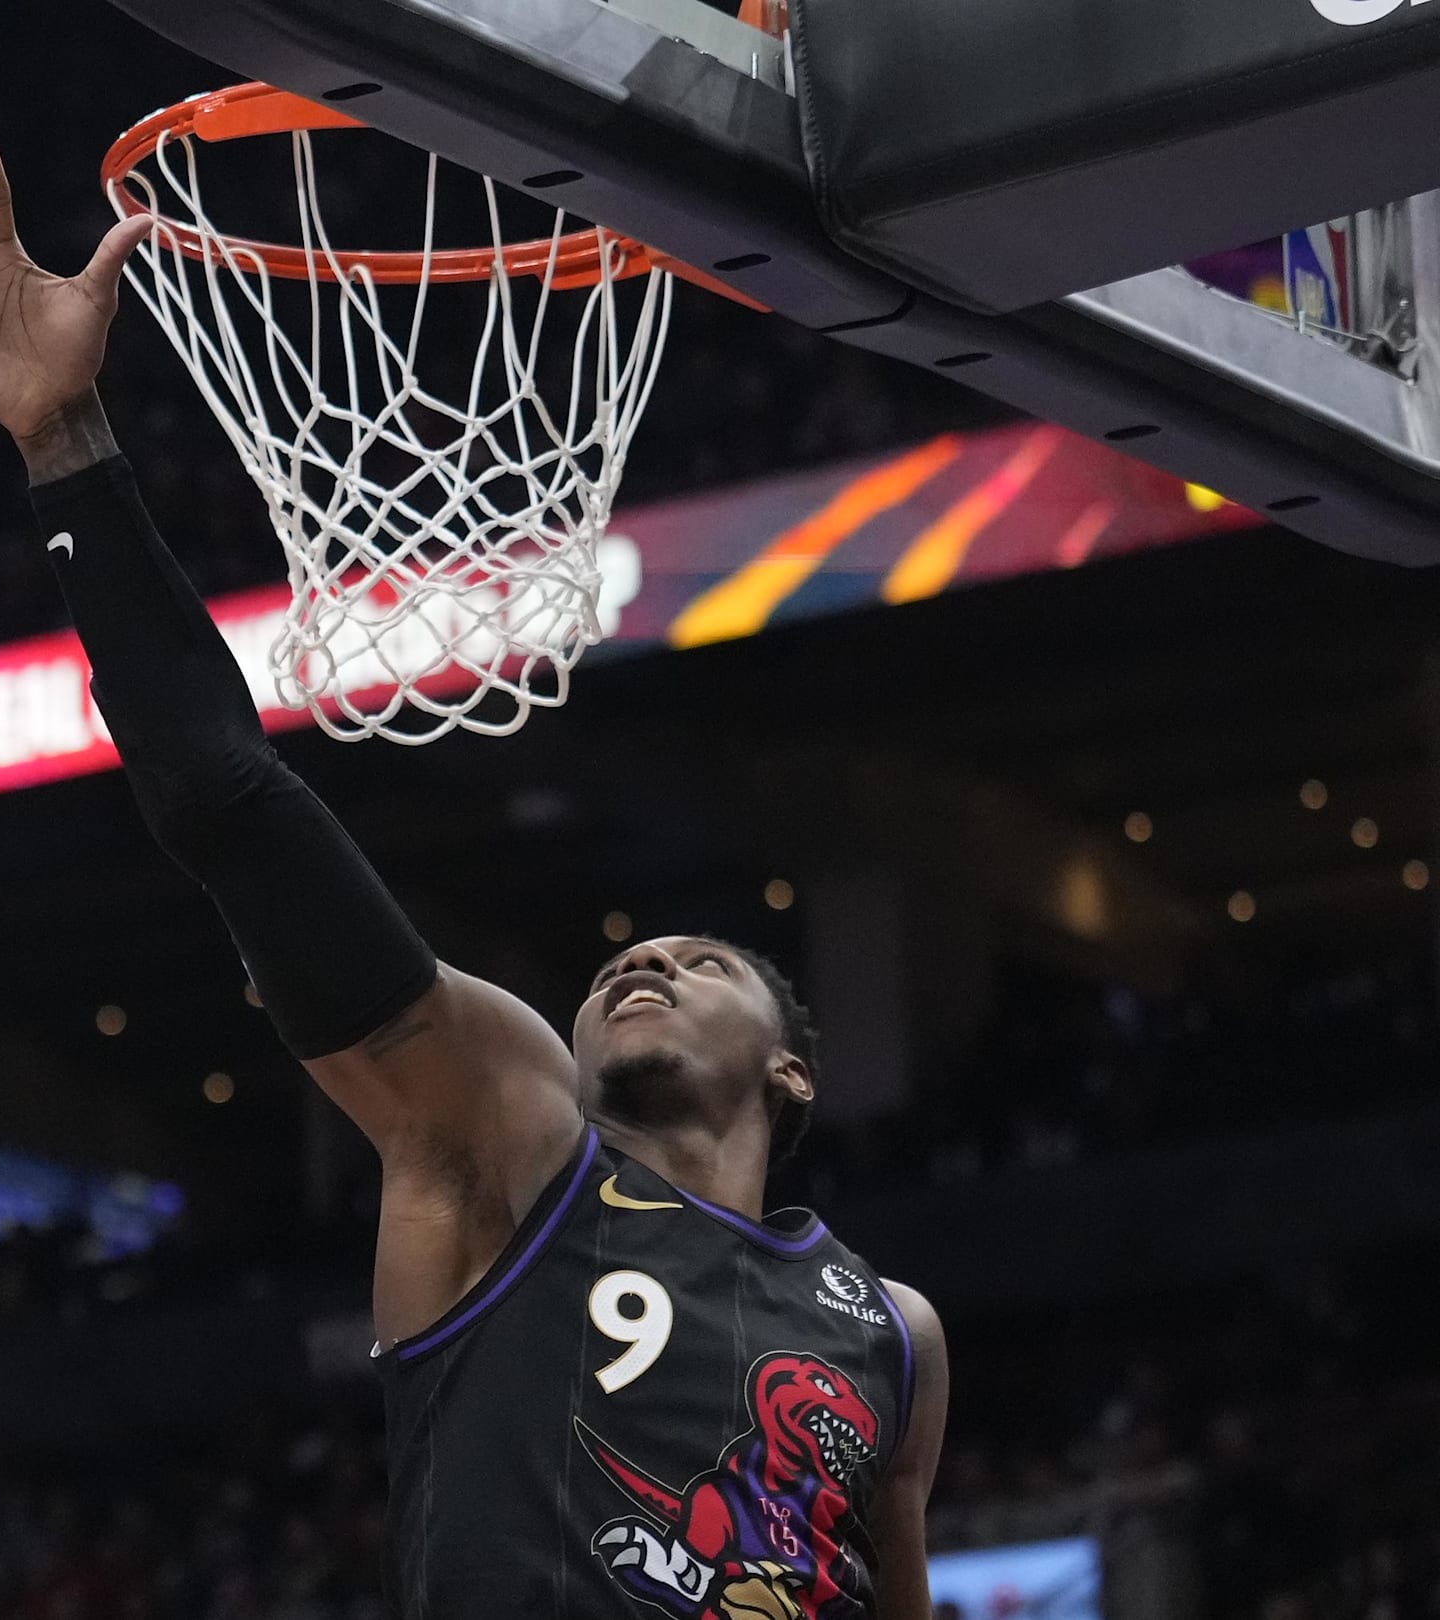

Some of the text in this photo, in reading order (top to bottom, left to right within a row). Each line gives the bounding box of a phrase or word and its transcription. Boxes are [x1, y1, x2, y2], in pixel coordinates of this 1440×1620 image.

[815, 1289, 888, 1326] Sun Life
[589, 1269, 673, 1394] 9
[769, 1522, 799, 1557] 15
